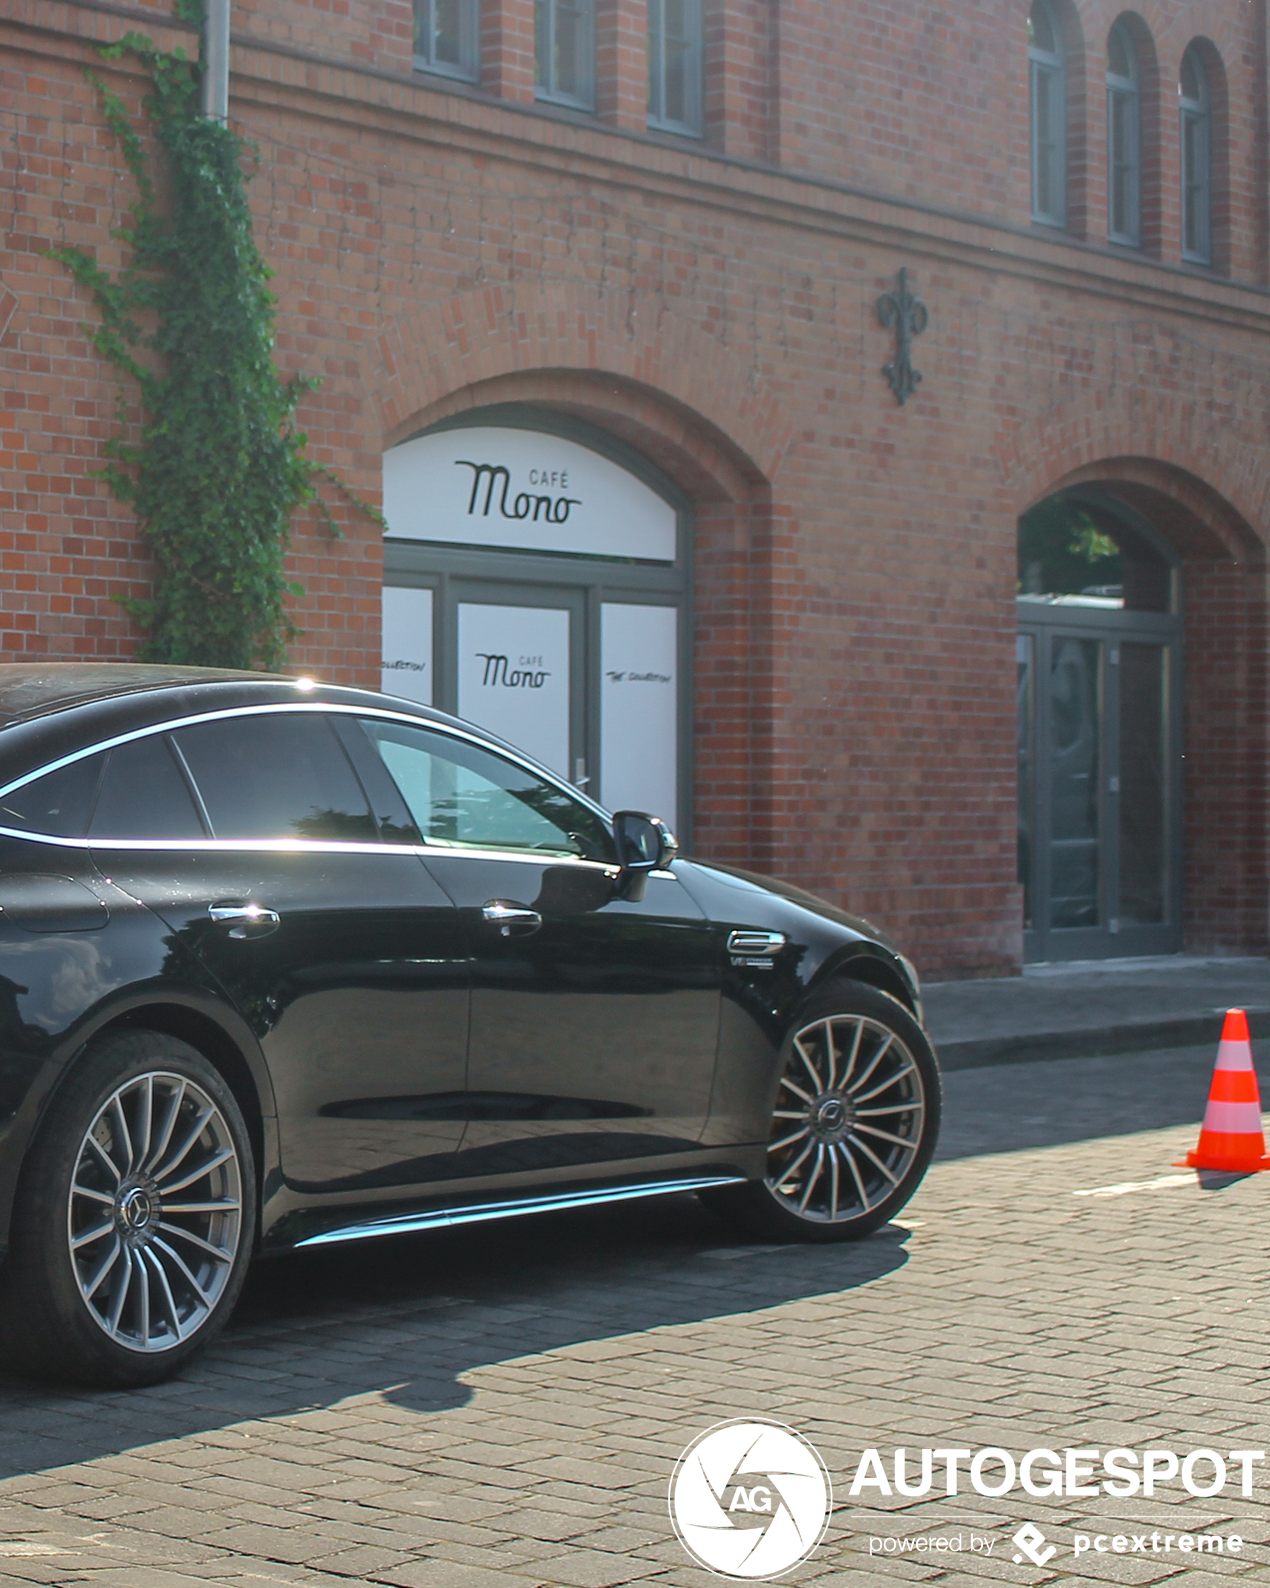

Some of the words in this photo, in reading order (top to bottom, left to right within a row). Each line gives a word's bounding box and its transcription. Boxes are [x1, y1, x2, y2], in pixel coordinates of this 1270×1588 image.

[454, 460, 582, 523] Mono
[529, 469, 569, 489] CAFÉ
[475, 652, 551, 688] Mono
